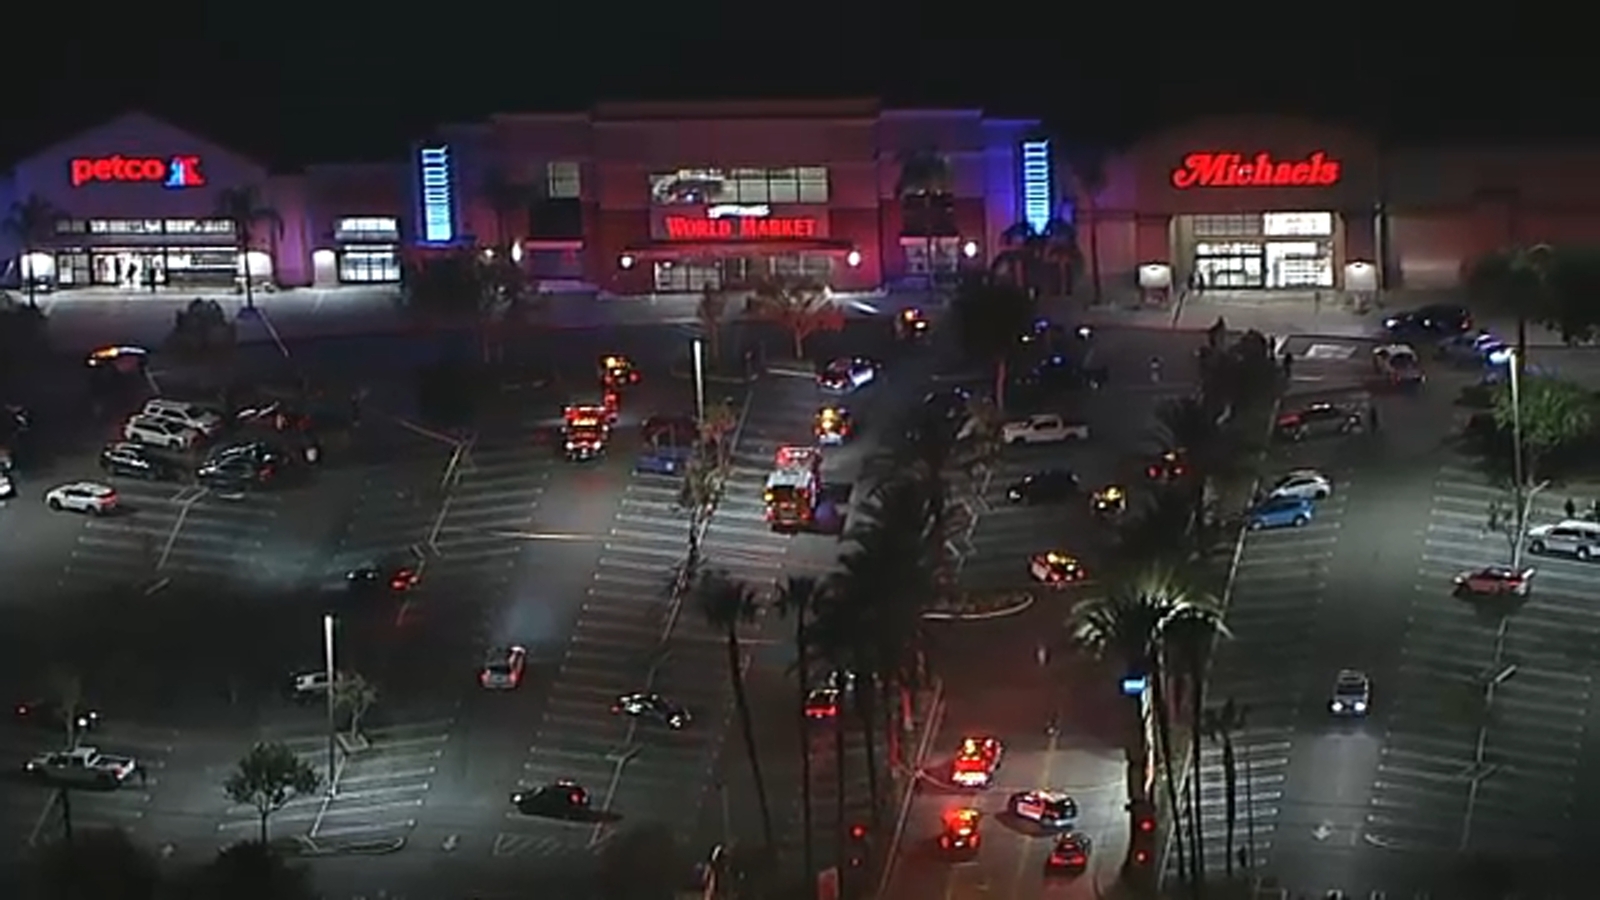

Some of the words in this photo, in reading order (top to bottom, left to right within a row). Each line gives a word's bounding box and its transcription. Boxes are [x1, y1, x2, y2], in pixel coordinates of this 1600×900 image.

[71, 154, 166, 187] petco
[1172, 151, 1341, 188] Michaels
[666, 217, 732, 238] WORLD
[739, 217, 816, 237] MARKET
